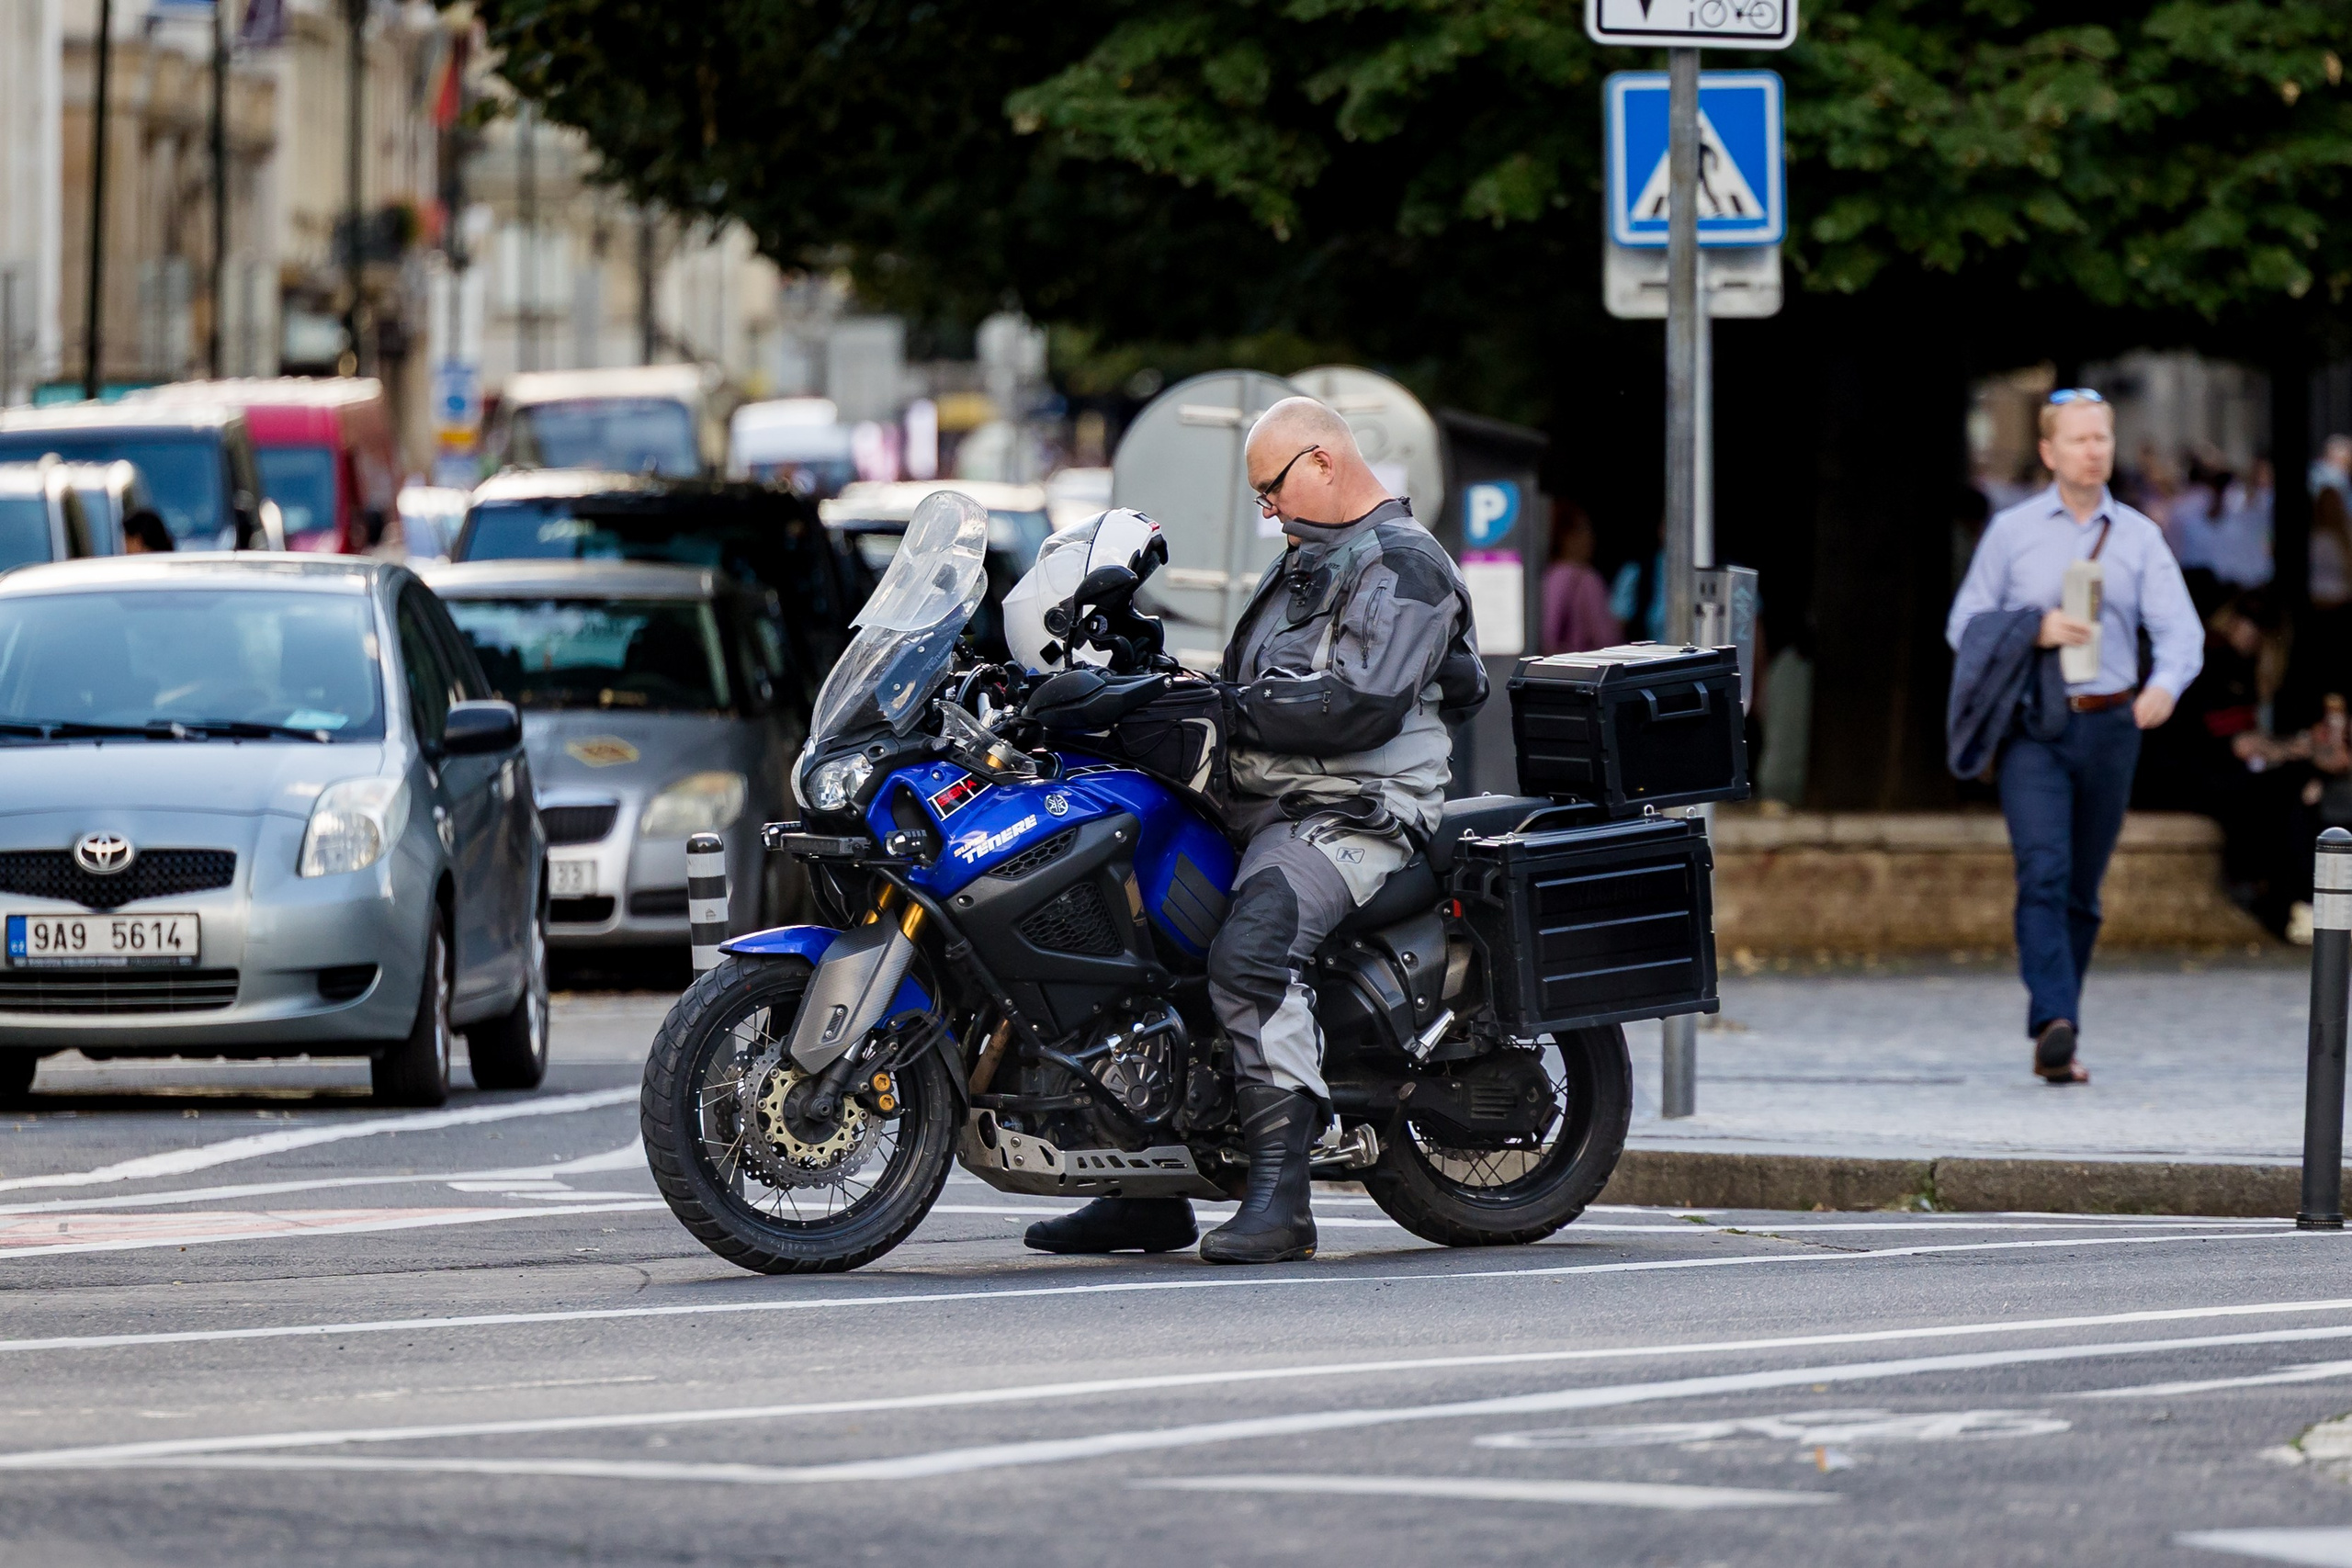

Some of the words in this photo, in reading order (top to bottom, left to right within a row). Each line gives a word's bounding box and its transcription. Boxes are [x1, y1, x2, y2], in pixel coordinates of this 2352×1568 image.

[1469, 484, 1508, 539] P
[937, 779, 977, 807] SENA
[34, 922, 86, 951] 9A9
[111, 921, 182, 950] 5614
